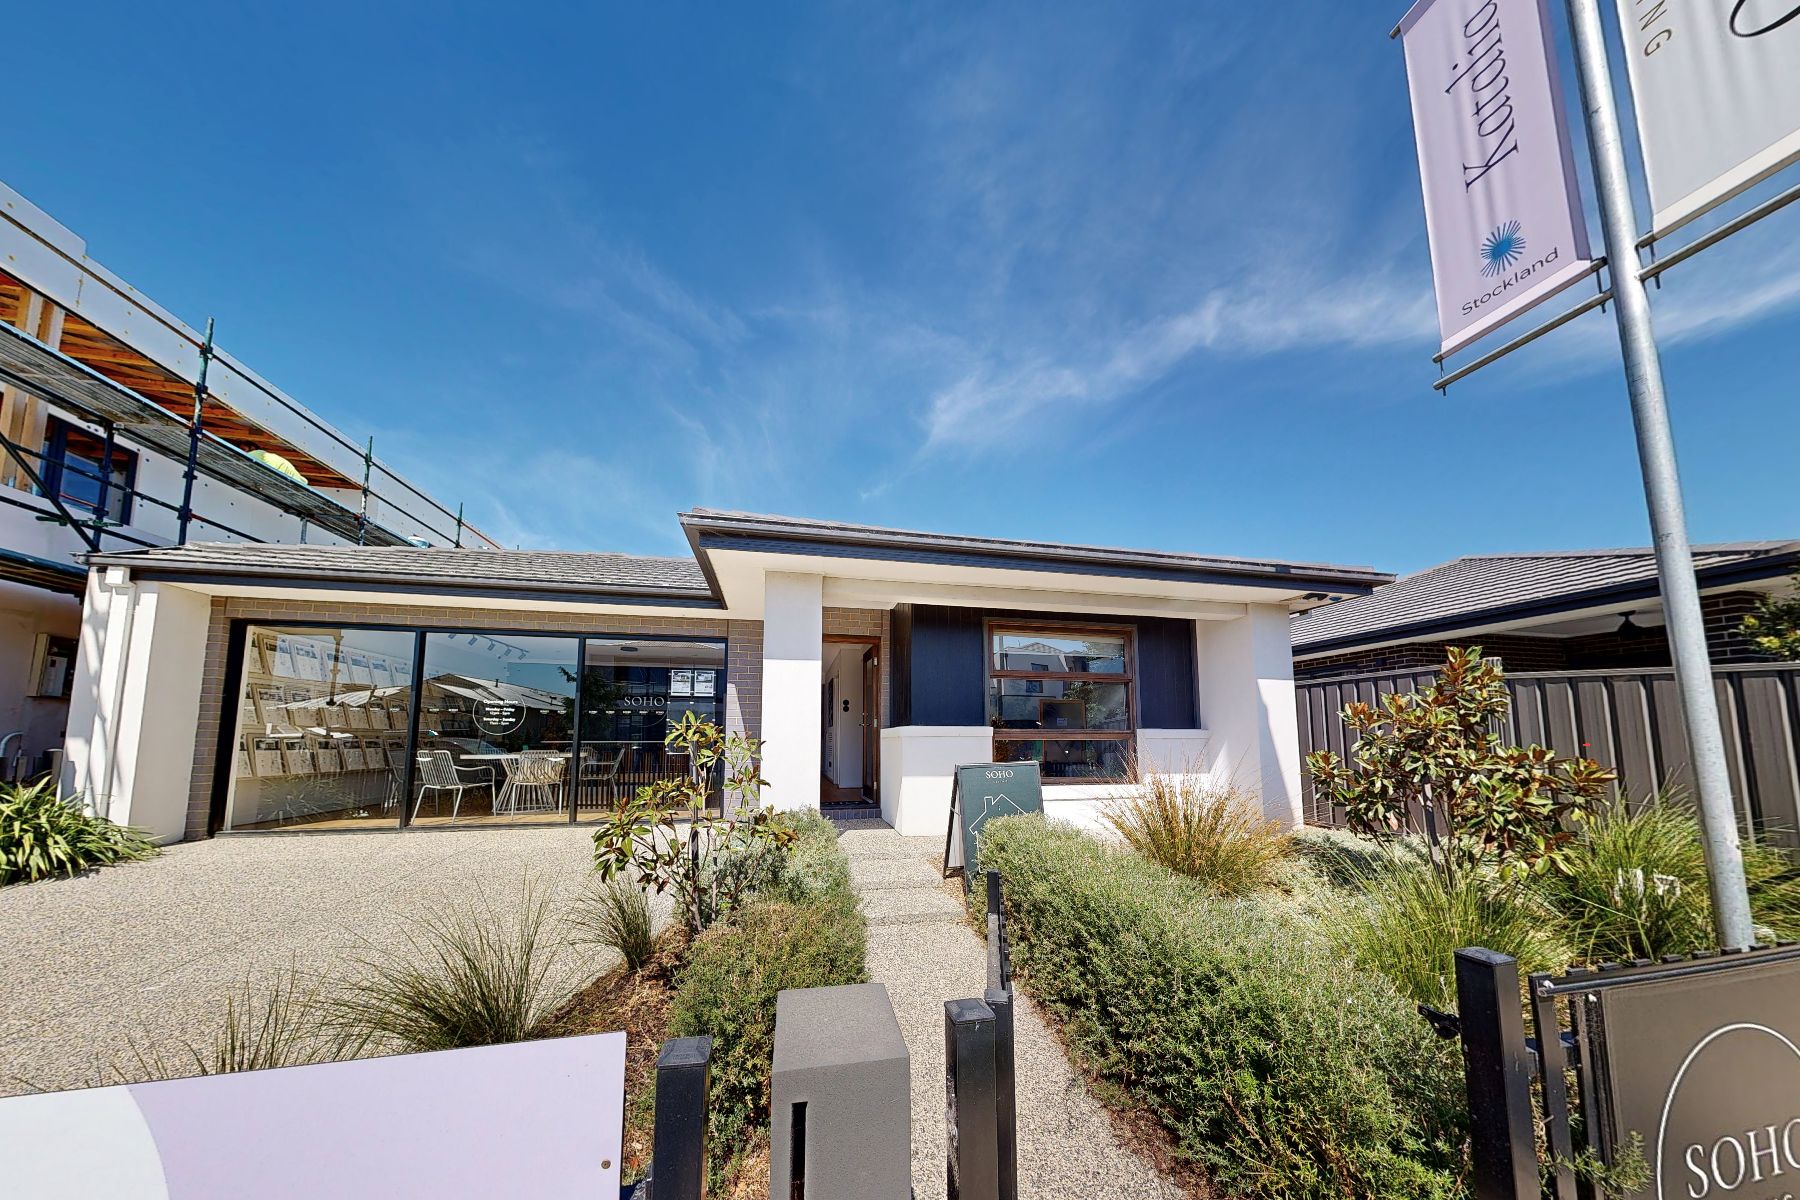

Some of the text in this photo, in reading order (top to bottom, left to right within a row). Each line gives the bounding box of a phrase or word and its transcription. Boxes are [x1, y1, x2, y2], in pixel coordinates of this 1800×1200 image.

[1461, 246, 1559, 316] Stockland
[623, 696, 665, 707] SOHO
[985, 769, 1014, 779] SOHO
